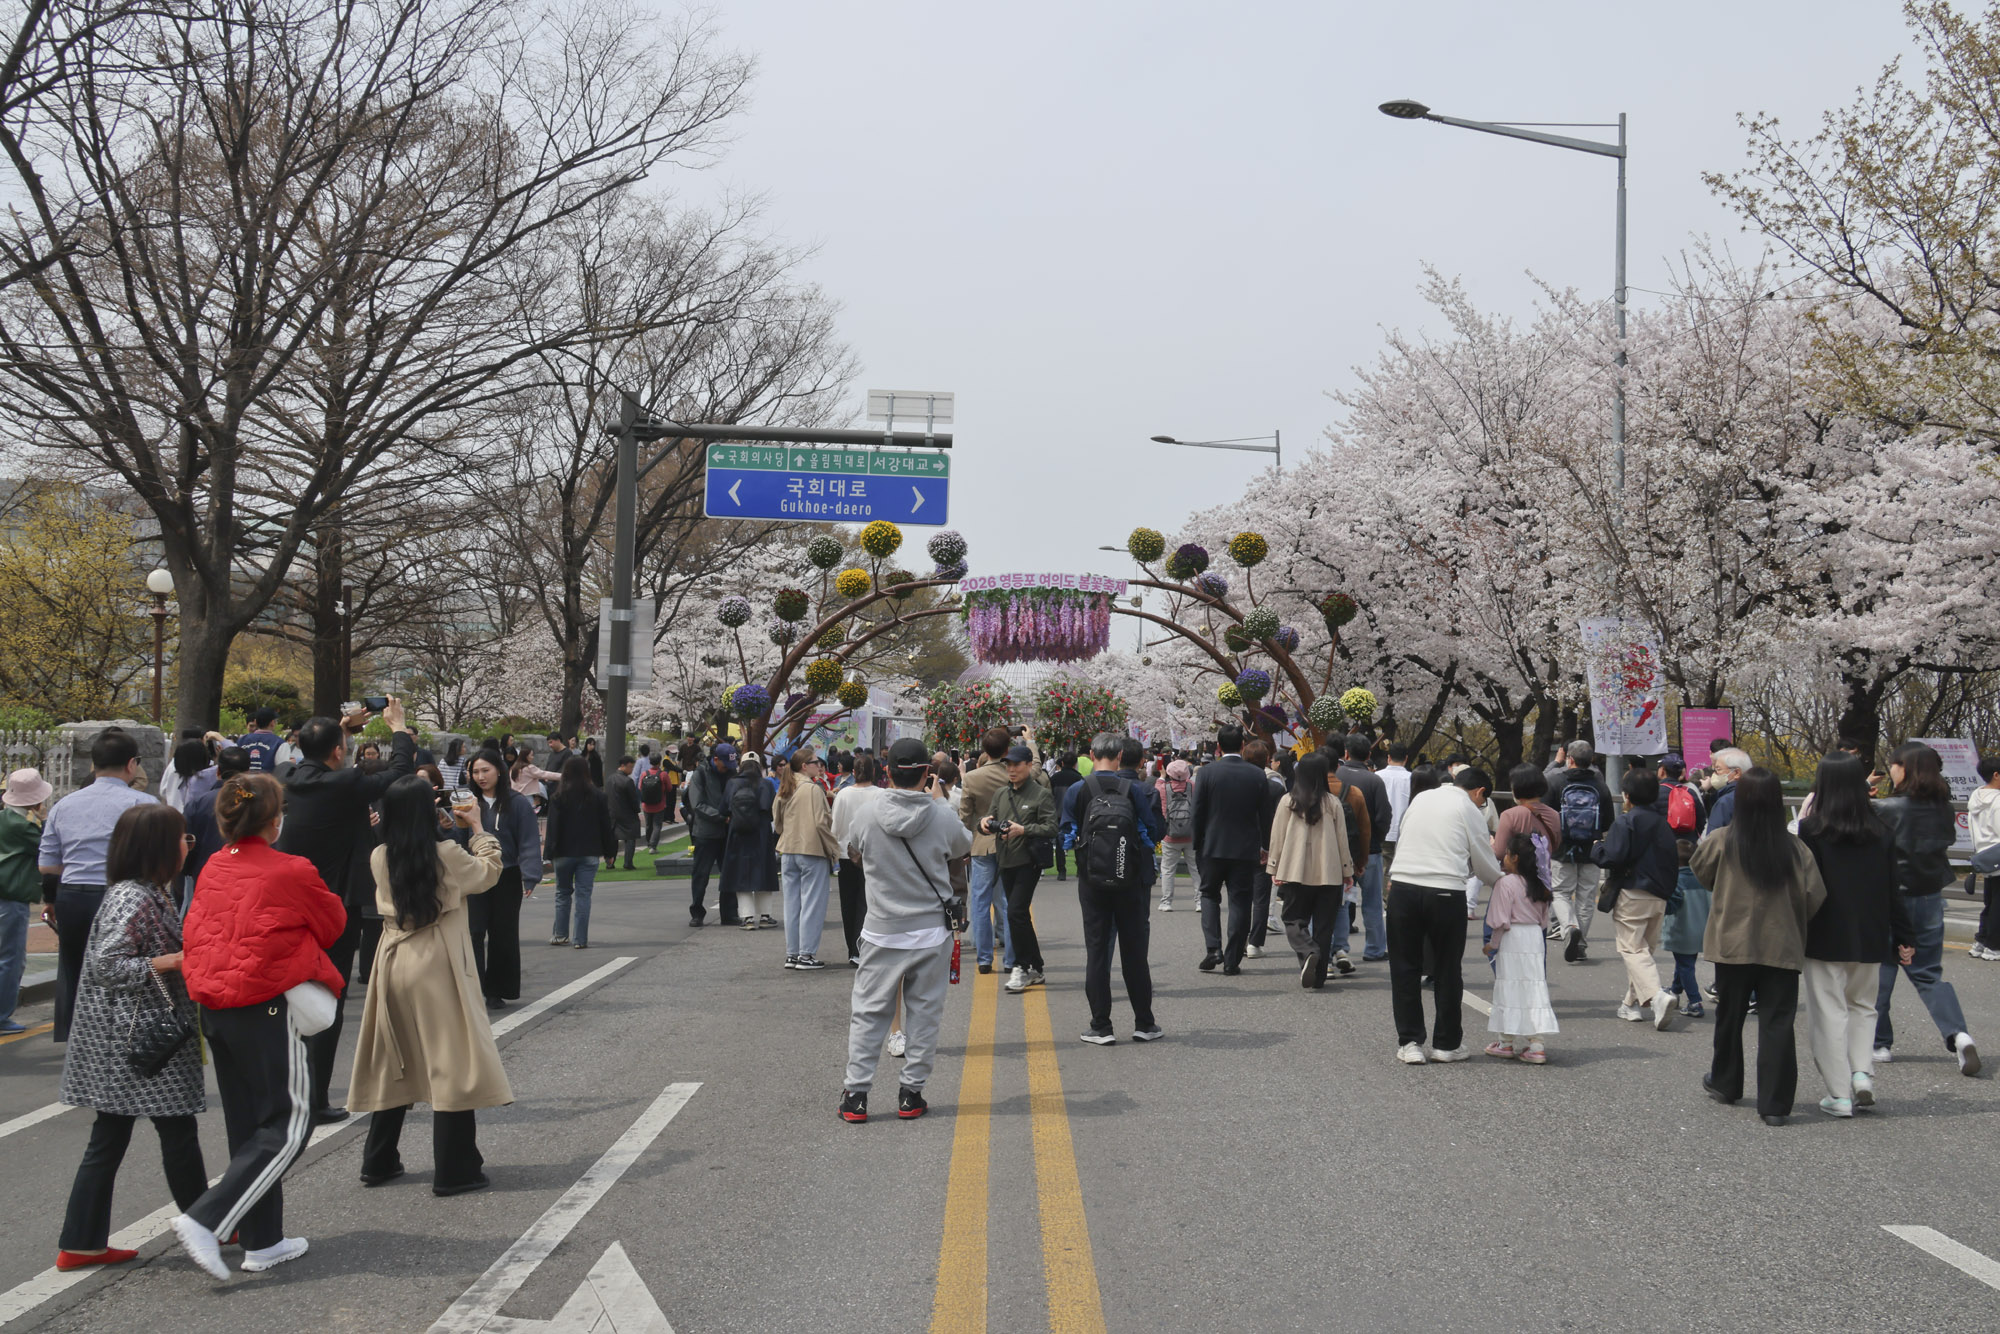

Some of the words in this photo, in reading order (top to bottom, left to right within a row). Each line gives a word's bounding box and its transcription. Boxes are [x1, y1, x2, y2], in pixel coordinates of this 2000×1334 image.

[728, 450, 784, 467] 국회의사당
[809, 453, 865, 469] 올림픽대로
[874, 457, 928, 472] 서강대교
[787, 478, 867, 498] 국회대로
[780, 499, 872, 516] Gukhoe-daero
[960, 576, 997, 592] 2026
[999, 573, 1036, 589] 영등포
[1039, 573, 1076, 589] 여의도
[1078, 575, 1129, 596] 봄꽃축제
